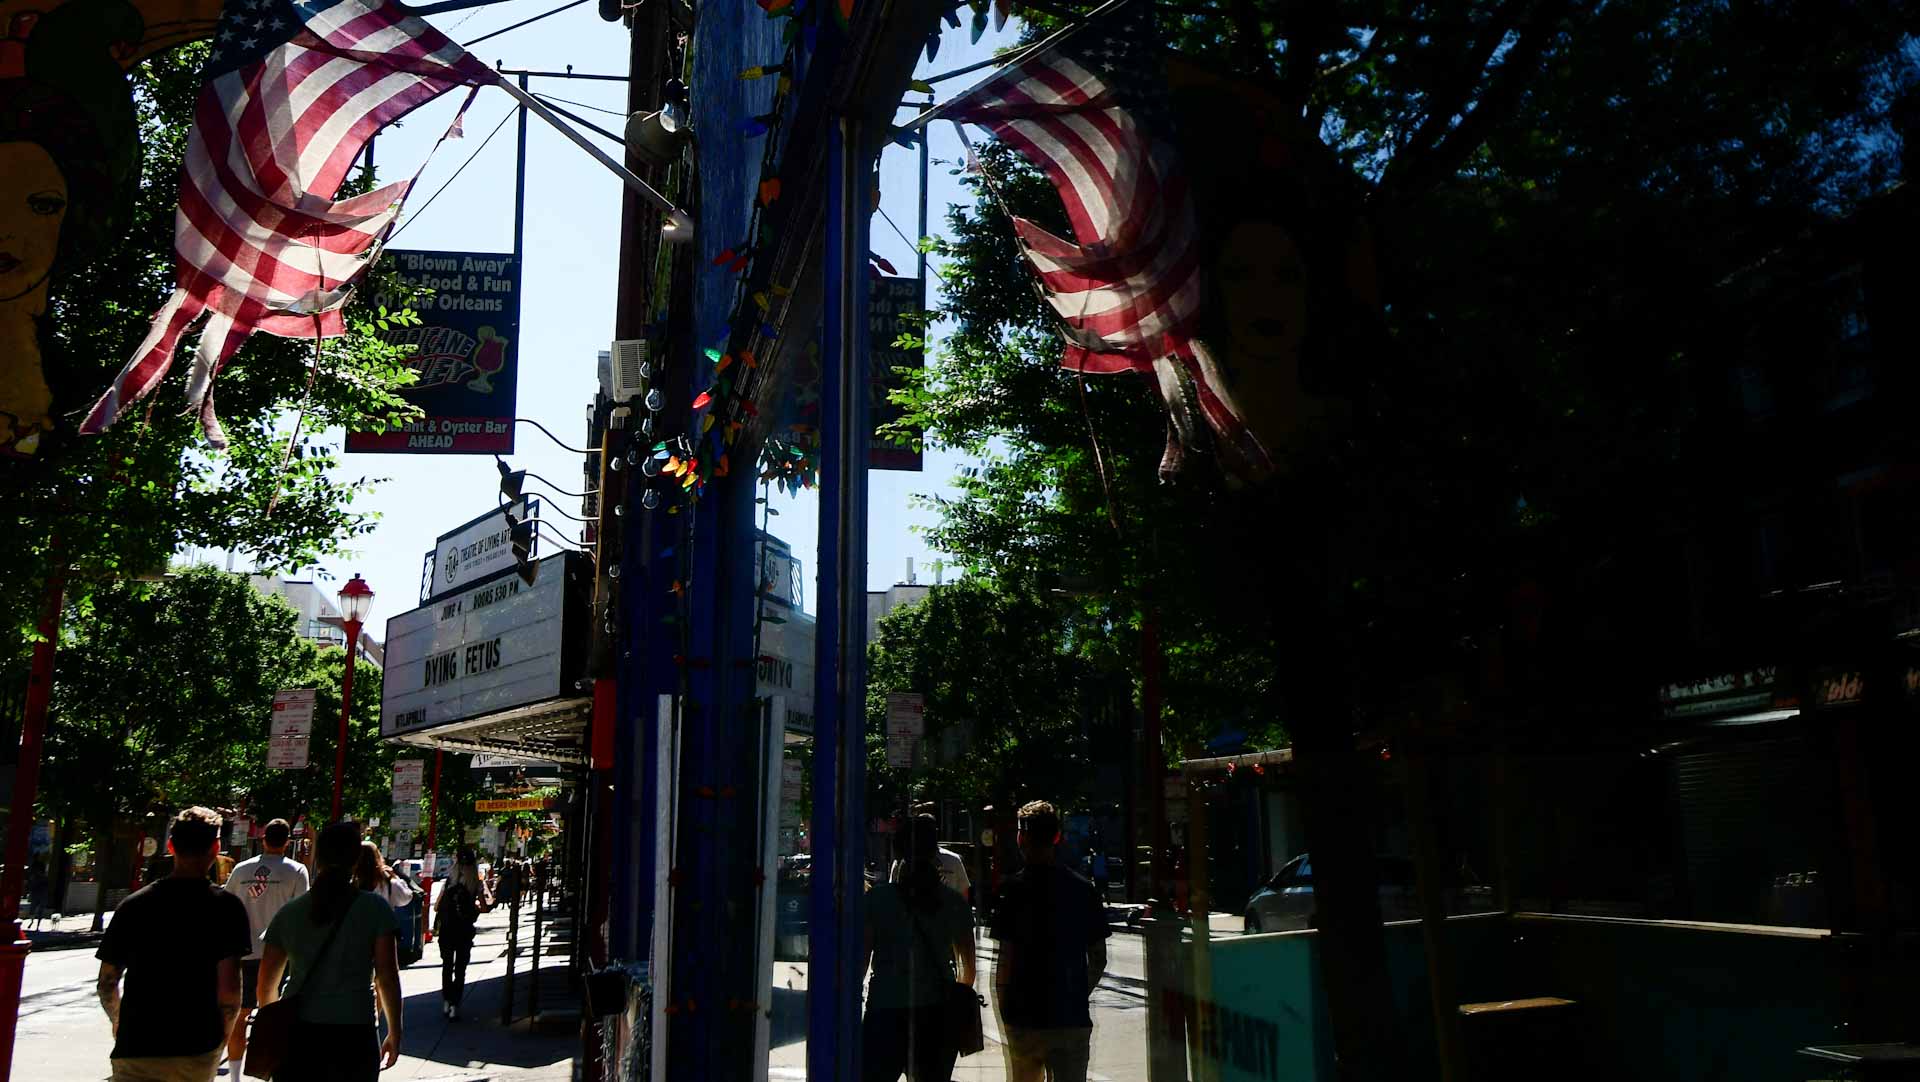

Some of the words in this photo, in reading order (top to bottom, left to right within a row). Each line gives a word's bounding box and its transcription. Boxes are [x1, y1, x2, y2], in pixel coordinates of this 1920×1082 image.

[400, 253, 458, 272] "Blown
[462, 256, 513, 276] Away"
[422, 273, 463, 291] Food
[467, 275, 479, 292] &
[483, 275, 512, 293] Fun
[439, 294, 504, 312] Orleans
[428, 420, 438, 433] &
[441, 420, 482, 435] Oyster
[485, 421, 508, 433] Bar
[408, 434, 454, 448] AHEAD
[473, 589, 493, 609] DOORS
[495, 585, 507, 603] 530
[424, 651, 457, 687] DYING
[465, 637, 501, 675] FETUS
